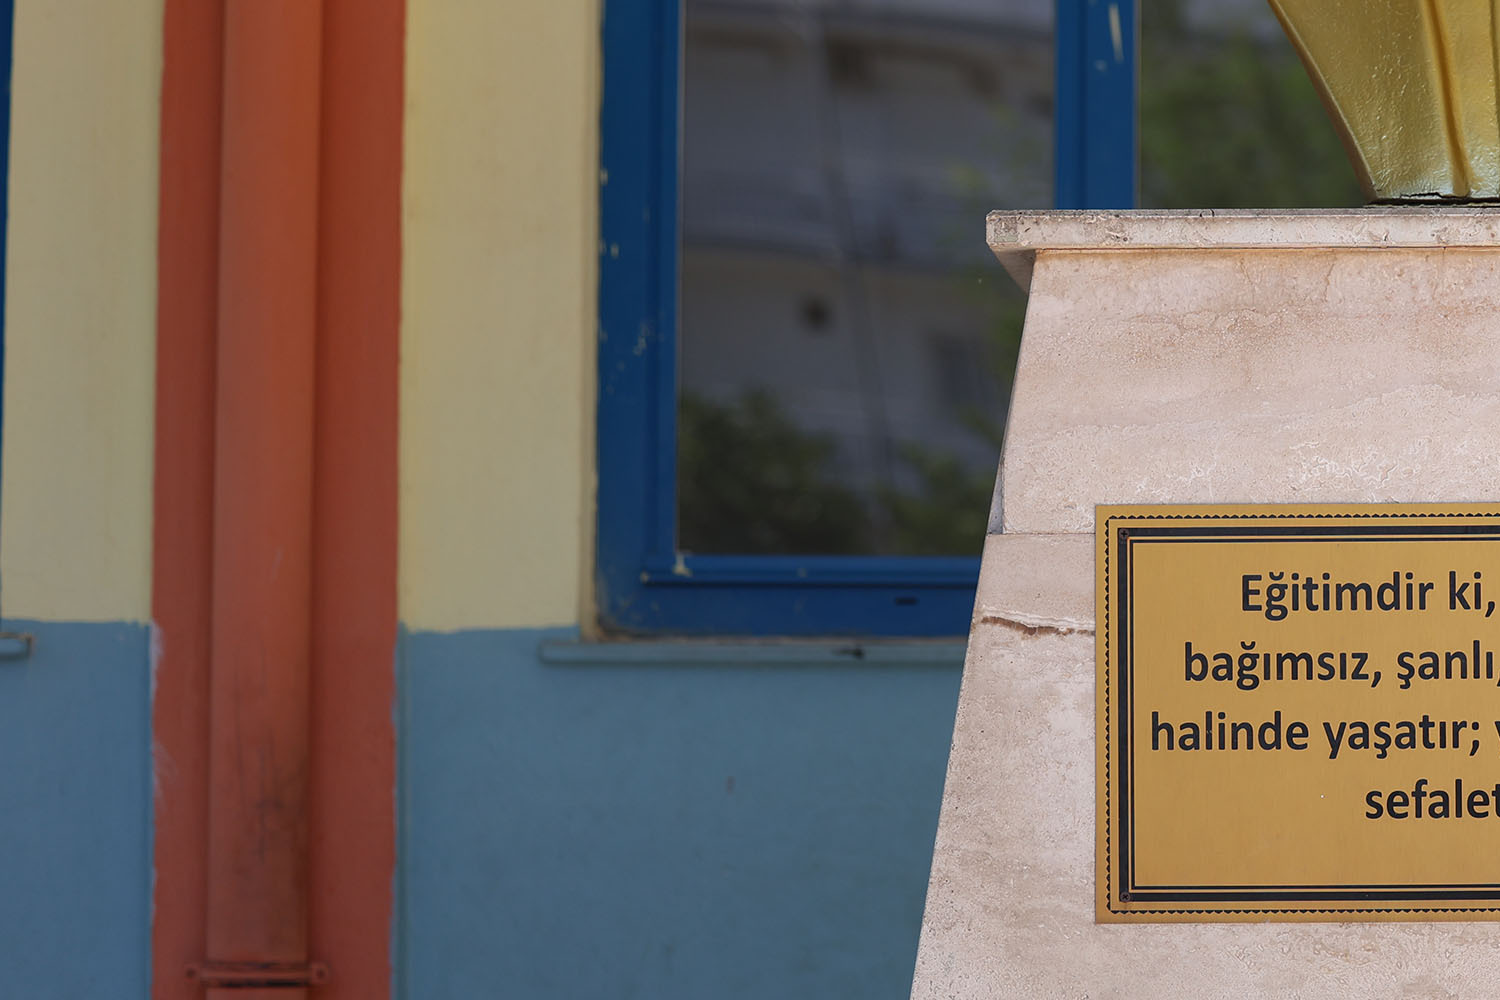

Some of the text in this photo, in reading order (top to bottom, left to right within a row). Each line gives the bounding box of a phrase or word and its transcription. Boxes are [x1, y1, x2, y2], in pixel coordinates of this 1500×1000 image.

[1241, 571, 1435, 621] Eğitimdir
[1448, 570, 1496, 618] ki,
[1184, 640, 1382, 690] bağımsız,
[1151, 710, 1309, 751] halinde
[1322, 714, 1480, 760] yaşatır;
